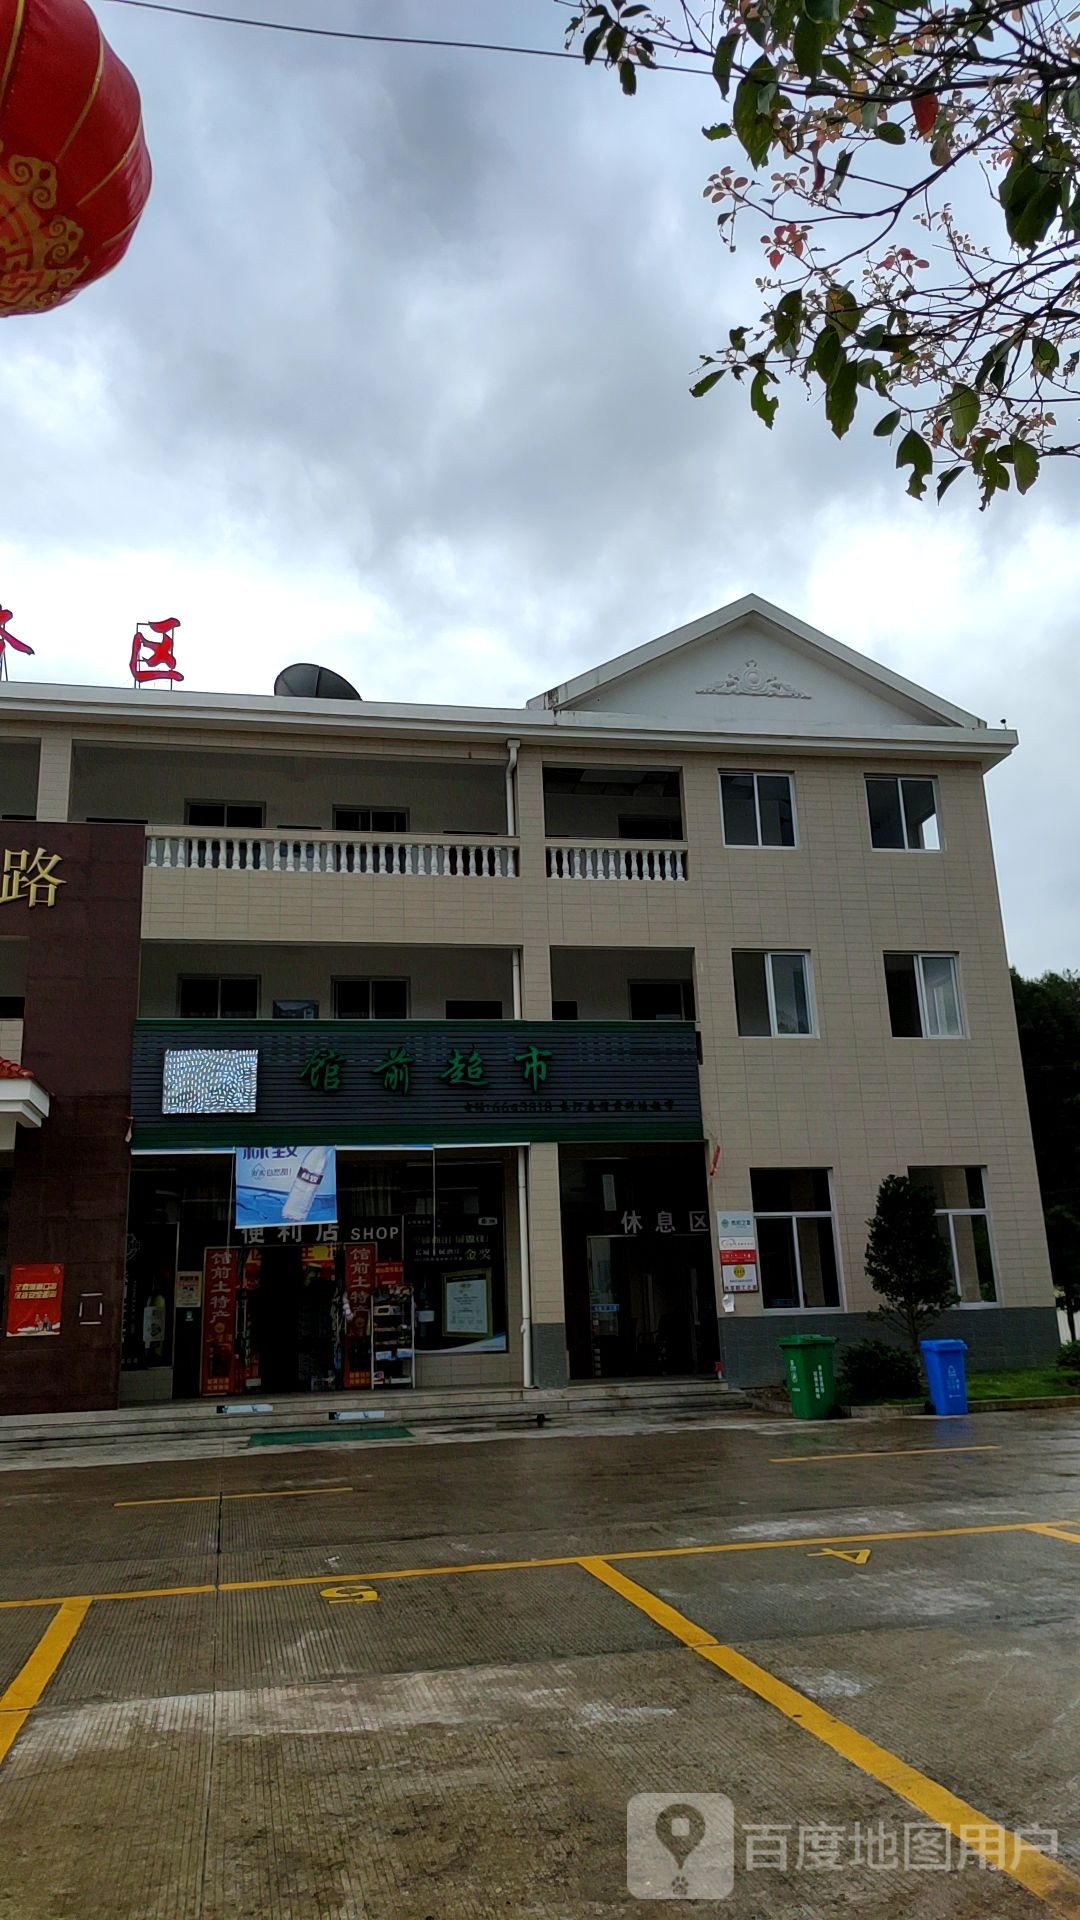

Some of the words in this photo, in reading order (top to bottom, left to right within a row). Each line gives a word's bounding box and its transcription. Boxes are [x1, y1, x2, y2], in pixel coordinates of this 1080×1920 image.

[0, 848, 67, 907] 路
[298, 1044, 554, 1095] 馆前超市
[241, 1224, 340, 1243] 便利店
[351, 1227, 399, 1241] SHOP
[621, 1210, 709, 1234] 休息区
[209, 1251, 232, 1324] 馆前土特产
